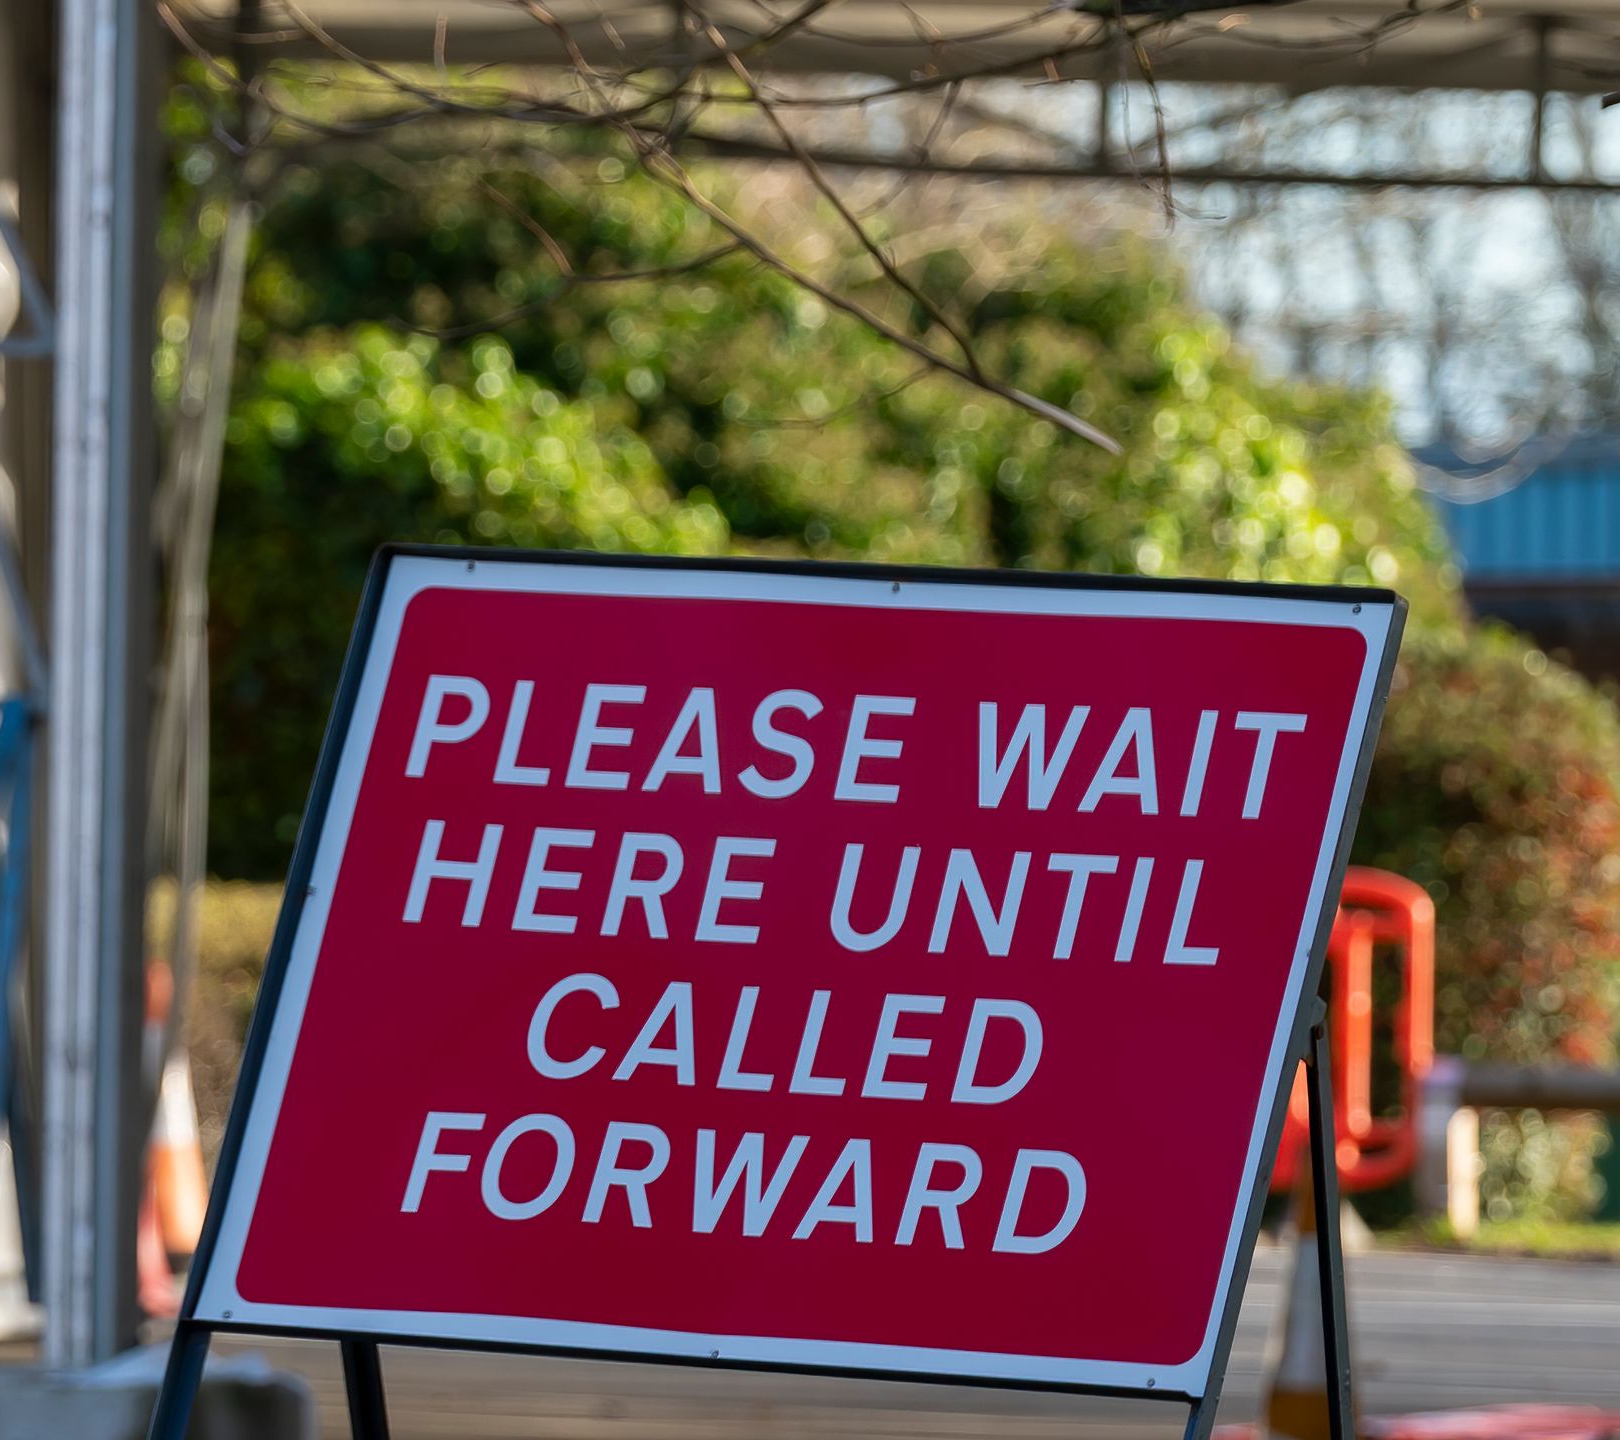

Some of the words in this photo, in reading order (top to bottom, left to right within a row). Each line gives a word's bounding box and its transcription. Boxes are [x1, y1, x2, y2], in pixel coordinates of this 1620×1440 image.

[405, 674, 917, 803] PLEASE
[978, 701, 1308, 820] WAIT
[402, 819, 777, 944] HERE
[830, 843, 1220, 966] UNTIL
[527, 973, 1044, 1104] CALLED
[400, 1111, 1087, 1254] FORWARD
